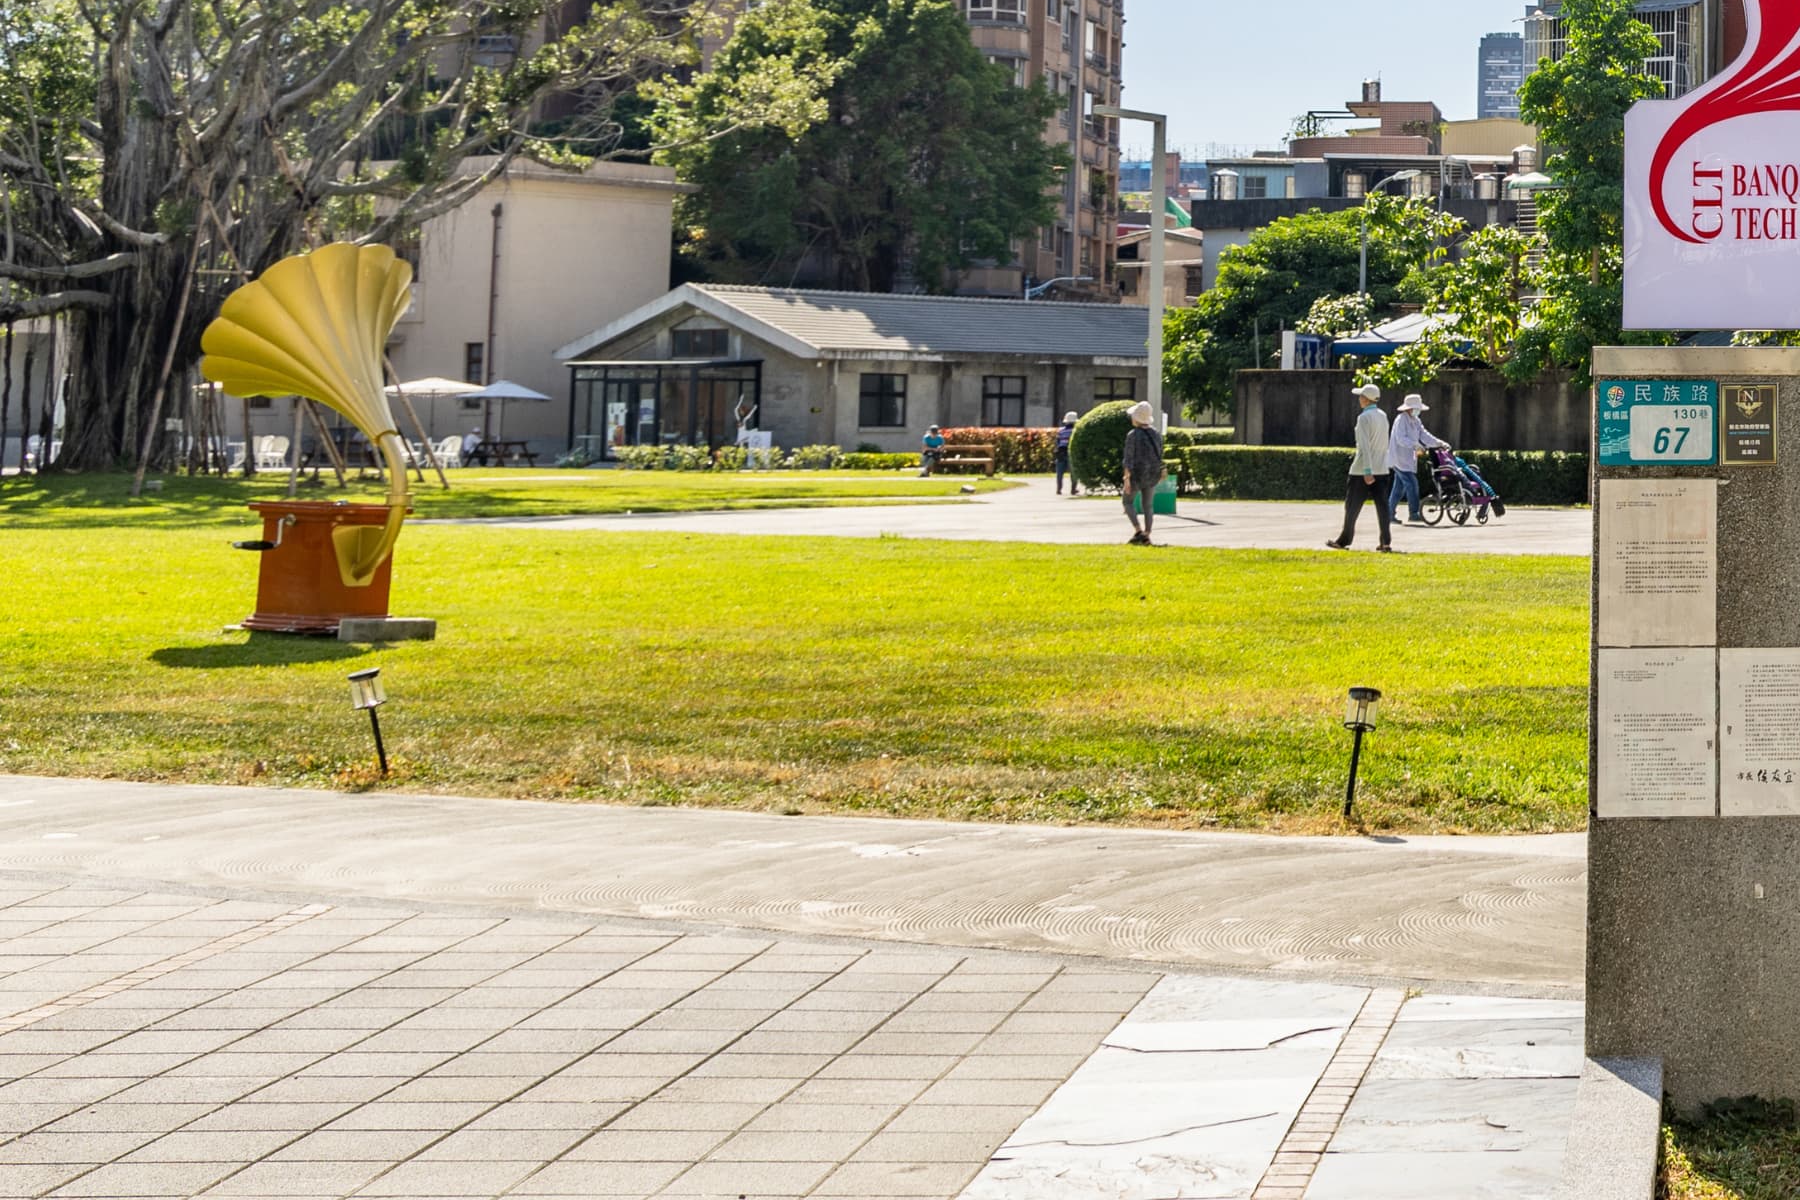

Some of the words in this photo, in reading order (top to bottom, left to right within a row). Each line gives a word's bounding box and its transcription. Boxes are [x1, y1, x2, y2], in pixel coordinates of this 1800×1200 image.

[1692, 160, 1723, 239] CLT
[1731, 207, 1797, 240] TECH
[1634, 384, 1709, 402] 民族路
[1603, 410, 1629, 420] 板橋區
[1653, 427, 1690, 454] 67
